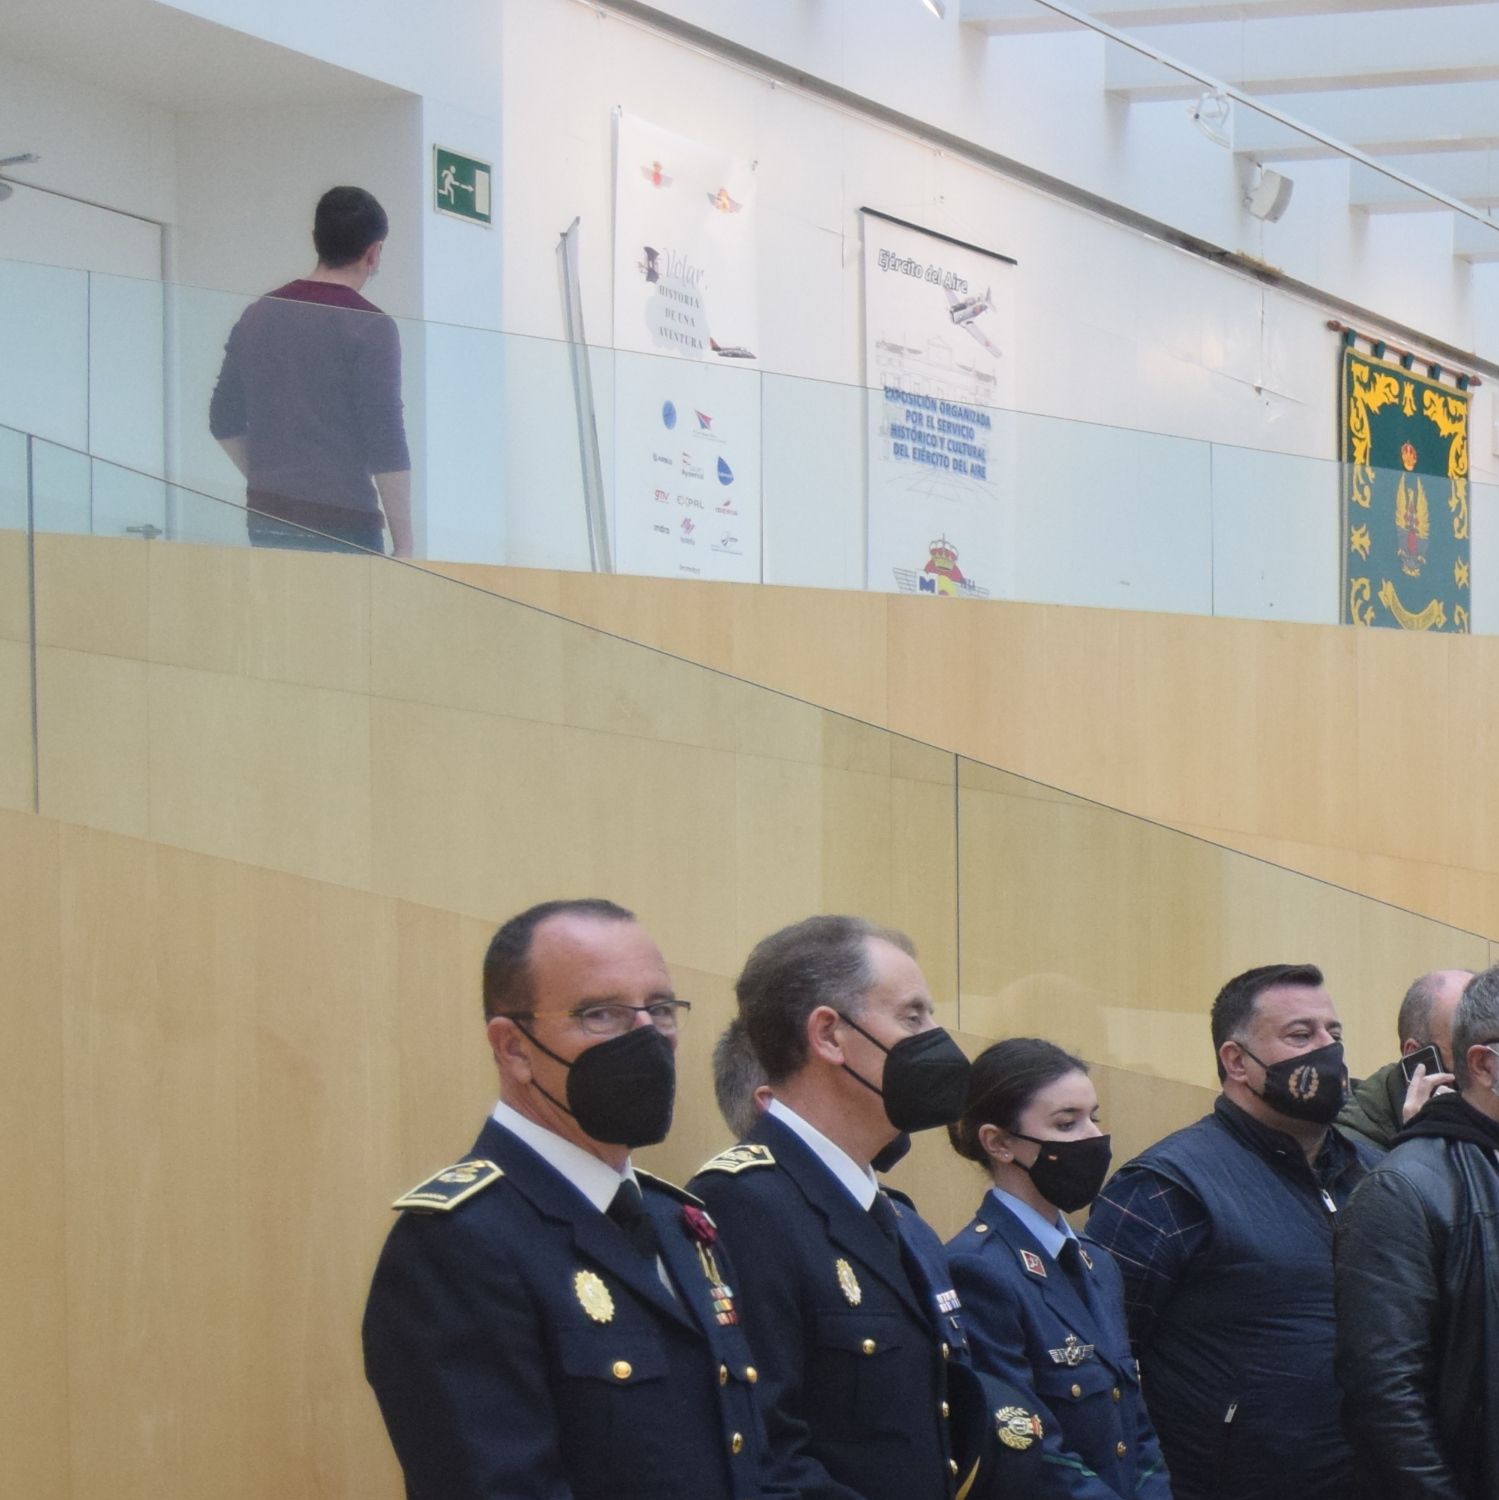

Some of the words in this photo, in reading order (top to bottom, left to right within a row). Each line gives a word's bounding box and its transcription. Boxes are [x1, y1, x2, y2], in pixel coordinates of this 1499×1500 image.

[879, 248, 923, 279] Ejército
[924, 264, 943, 286] del
[943, 271, 968, 294] Aire
[659, 285, 699, 309] HISTORIA
[665, 308, 676, 321] DE
[659, 326, 703, 350] AVENTURA
[884, 385, 937, 412] EXPOSICIÓN
[939, 401, 992, 430] ORGANIZADA
[906, 409, 924, 426] POR
[926, 415, 935, 430] EL
[937, 418, 975, 441] SERVICIO
[890, 423, 938, 448] HISTÓRICO
[939, 437, 946, 450] Y
[947, 439, 986, 463] CULTURAL
[893, 442, 910, 459] DEL
[912, 446, 950, 469] EJÉRCITO
[952, 457, 969, 475] DEL
[970, 463, 987, 480] AIRE
